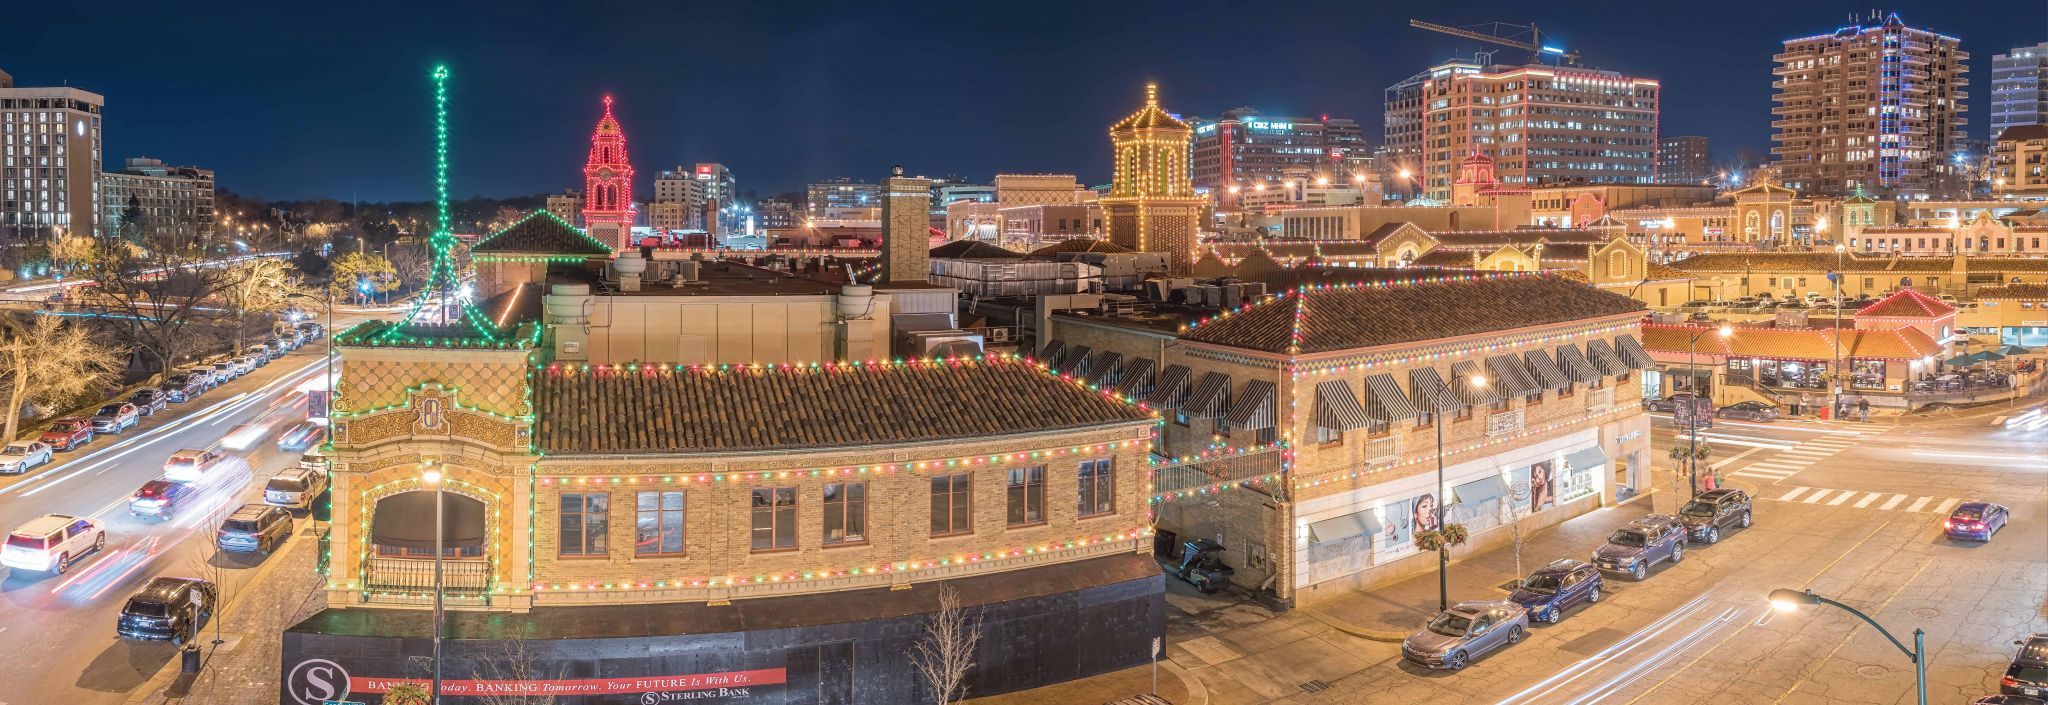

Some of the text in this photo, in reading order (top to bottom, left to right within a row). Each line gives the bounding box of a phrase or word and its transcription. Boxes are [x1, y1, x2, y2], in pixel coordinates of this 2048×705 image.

[306, 667, 335, 701] S
[439, 683, 471, 693] oday.
[476, 683, 538, 692] BANKING
[543, 683, 602, 692] Tomorrow.
[607, 681, 632, 690] Your
[636, 679, 687, 689] FUTURE
[691, 677, 700, 686] Is
[706, 676, 729, 685] With
[734, 675, 751, 683] Us.
